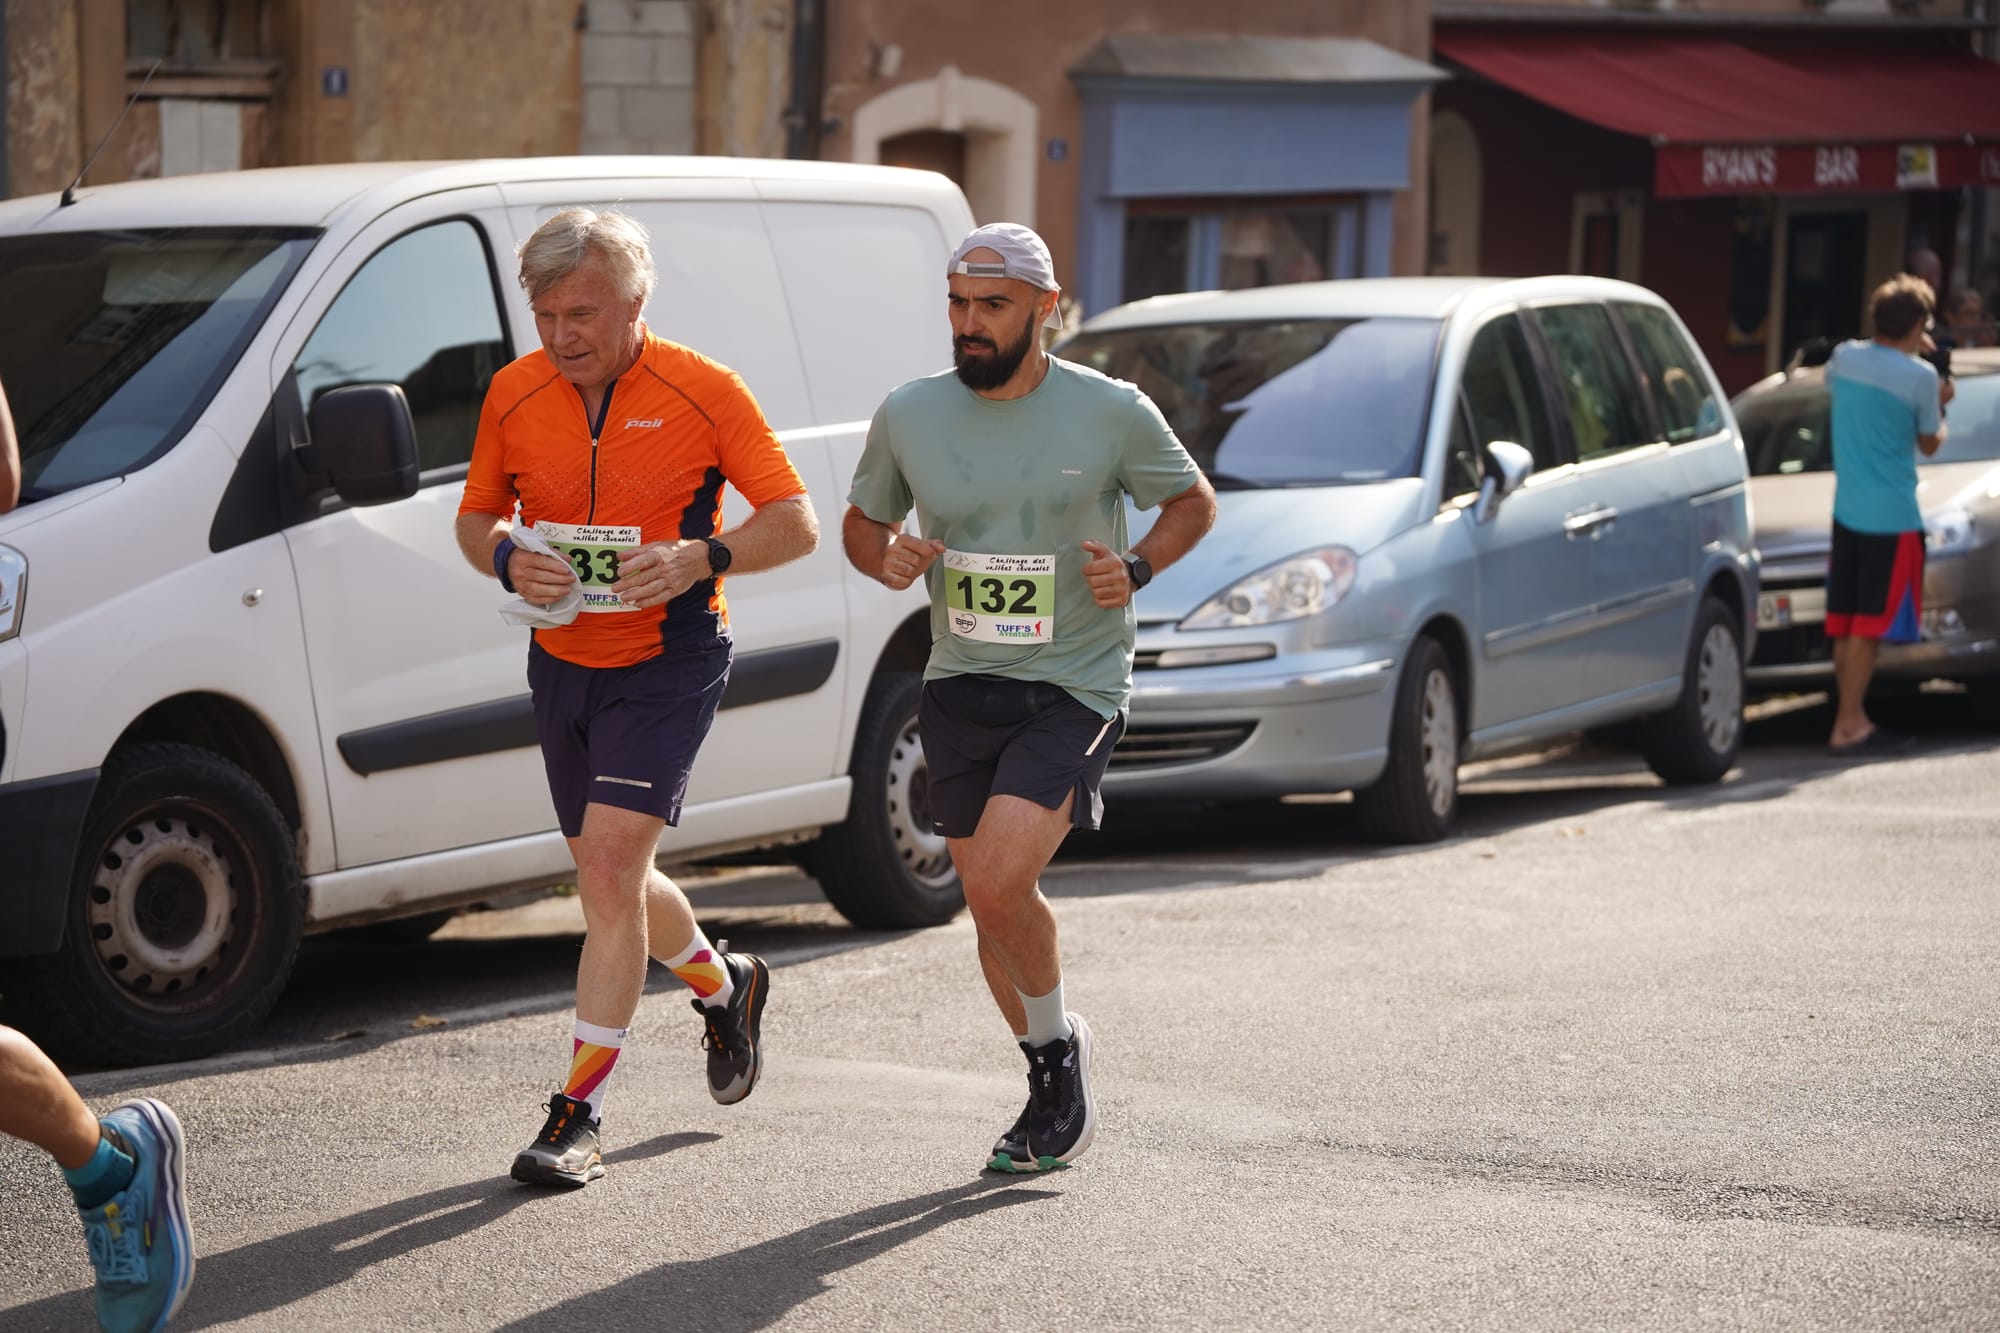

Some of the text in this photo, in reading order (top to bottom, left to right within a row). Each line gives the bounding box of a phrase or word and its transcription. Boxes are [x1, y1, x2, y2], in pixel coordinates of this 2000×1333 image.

[1702, 145, 1777, 186] RYAN'S
[1815, 145, 1859, 185] BAR
[576, 528, 614, 537] Challenge
[553, 546, 622, 584] 33
[990, 557, 1028, 566] Challenge
[583, 593, 618, 601] TUFF'S
[957, 576, 1037, 614] 132
[956, 617, 973, 627] BFP
[995, 624, 1031, 633] TUFF'S
